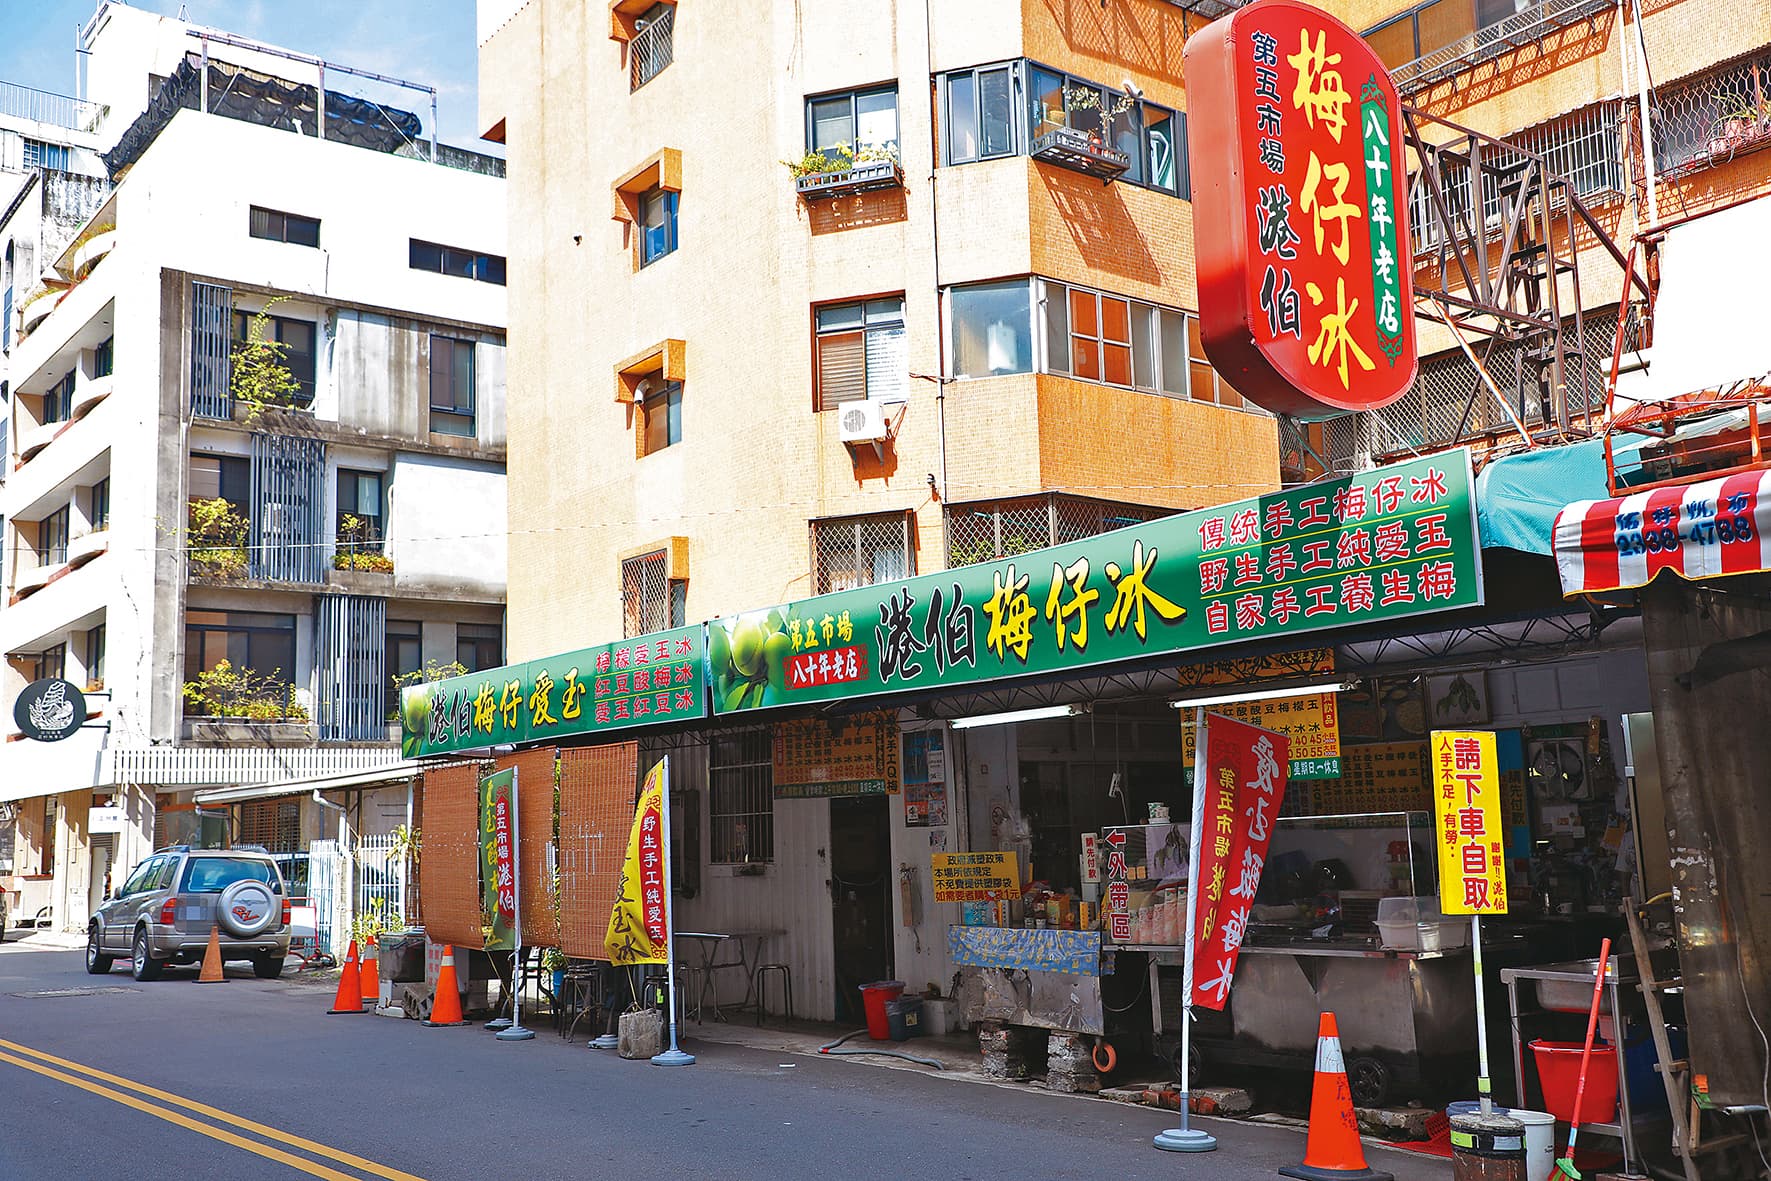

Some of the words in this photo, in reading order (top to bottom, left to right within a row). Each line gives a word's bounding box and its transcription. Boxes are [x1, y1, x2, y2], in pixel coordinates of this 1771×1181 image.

[1287, 27, 1376, 391] 梅仔冰
[1365, 109, 1398, 332] 八十年老店
[1197, 466, 1450, 552] 傳統手工梅仔冰
[1199, 512, 1454, 595] 野生手工純愛玉
[1616, 516, 1753, 557] 2338-4788
[1206, 561, 1457, 635] 自家手工養生梅
[595, 634, 693, 674] 檸檬愛玉冰
[789, 610, 854, 654] 第五市場
[594, 662, 693, 698] 紅豆酸梅冰
[791, 649, 858, 686] 八十年老店
[594, 688, 694, 724] 愛玉紅豆冰
[1295, 748, 1308, 758] 50
[1310, 734, 1322, 744] 45
[1310, 747, 1322, 757] 55
[1454, 738, 1491, 909] 請下車自取
[496, 802, 515, 911] 第五市場港伯
[642, 816, 663, 940] 野生手工純愛玉
[1085, 837, 1097, 879] 請先付款
[1108, 851, 1131, 941] 外帶區
